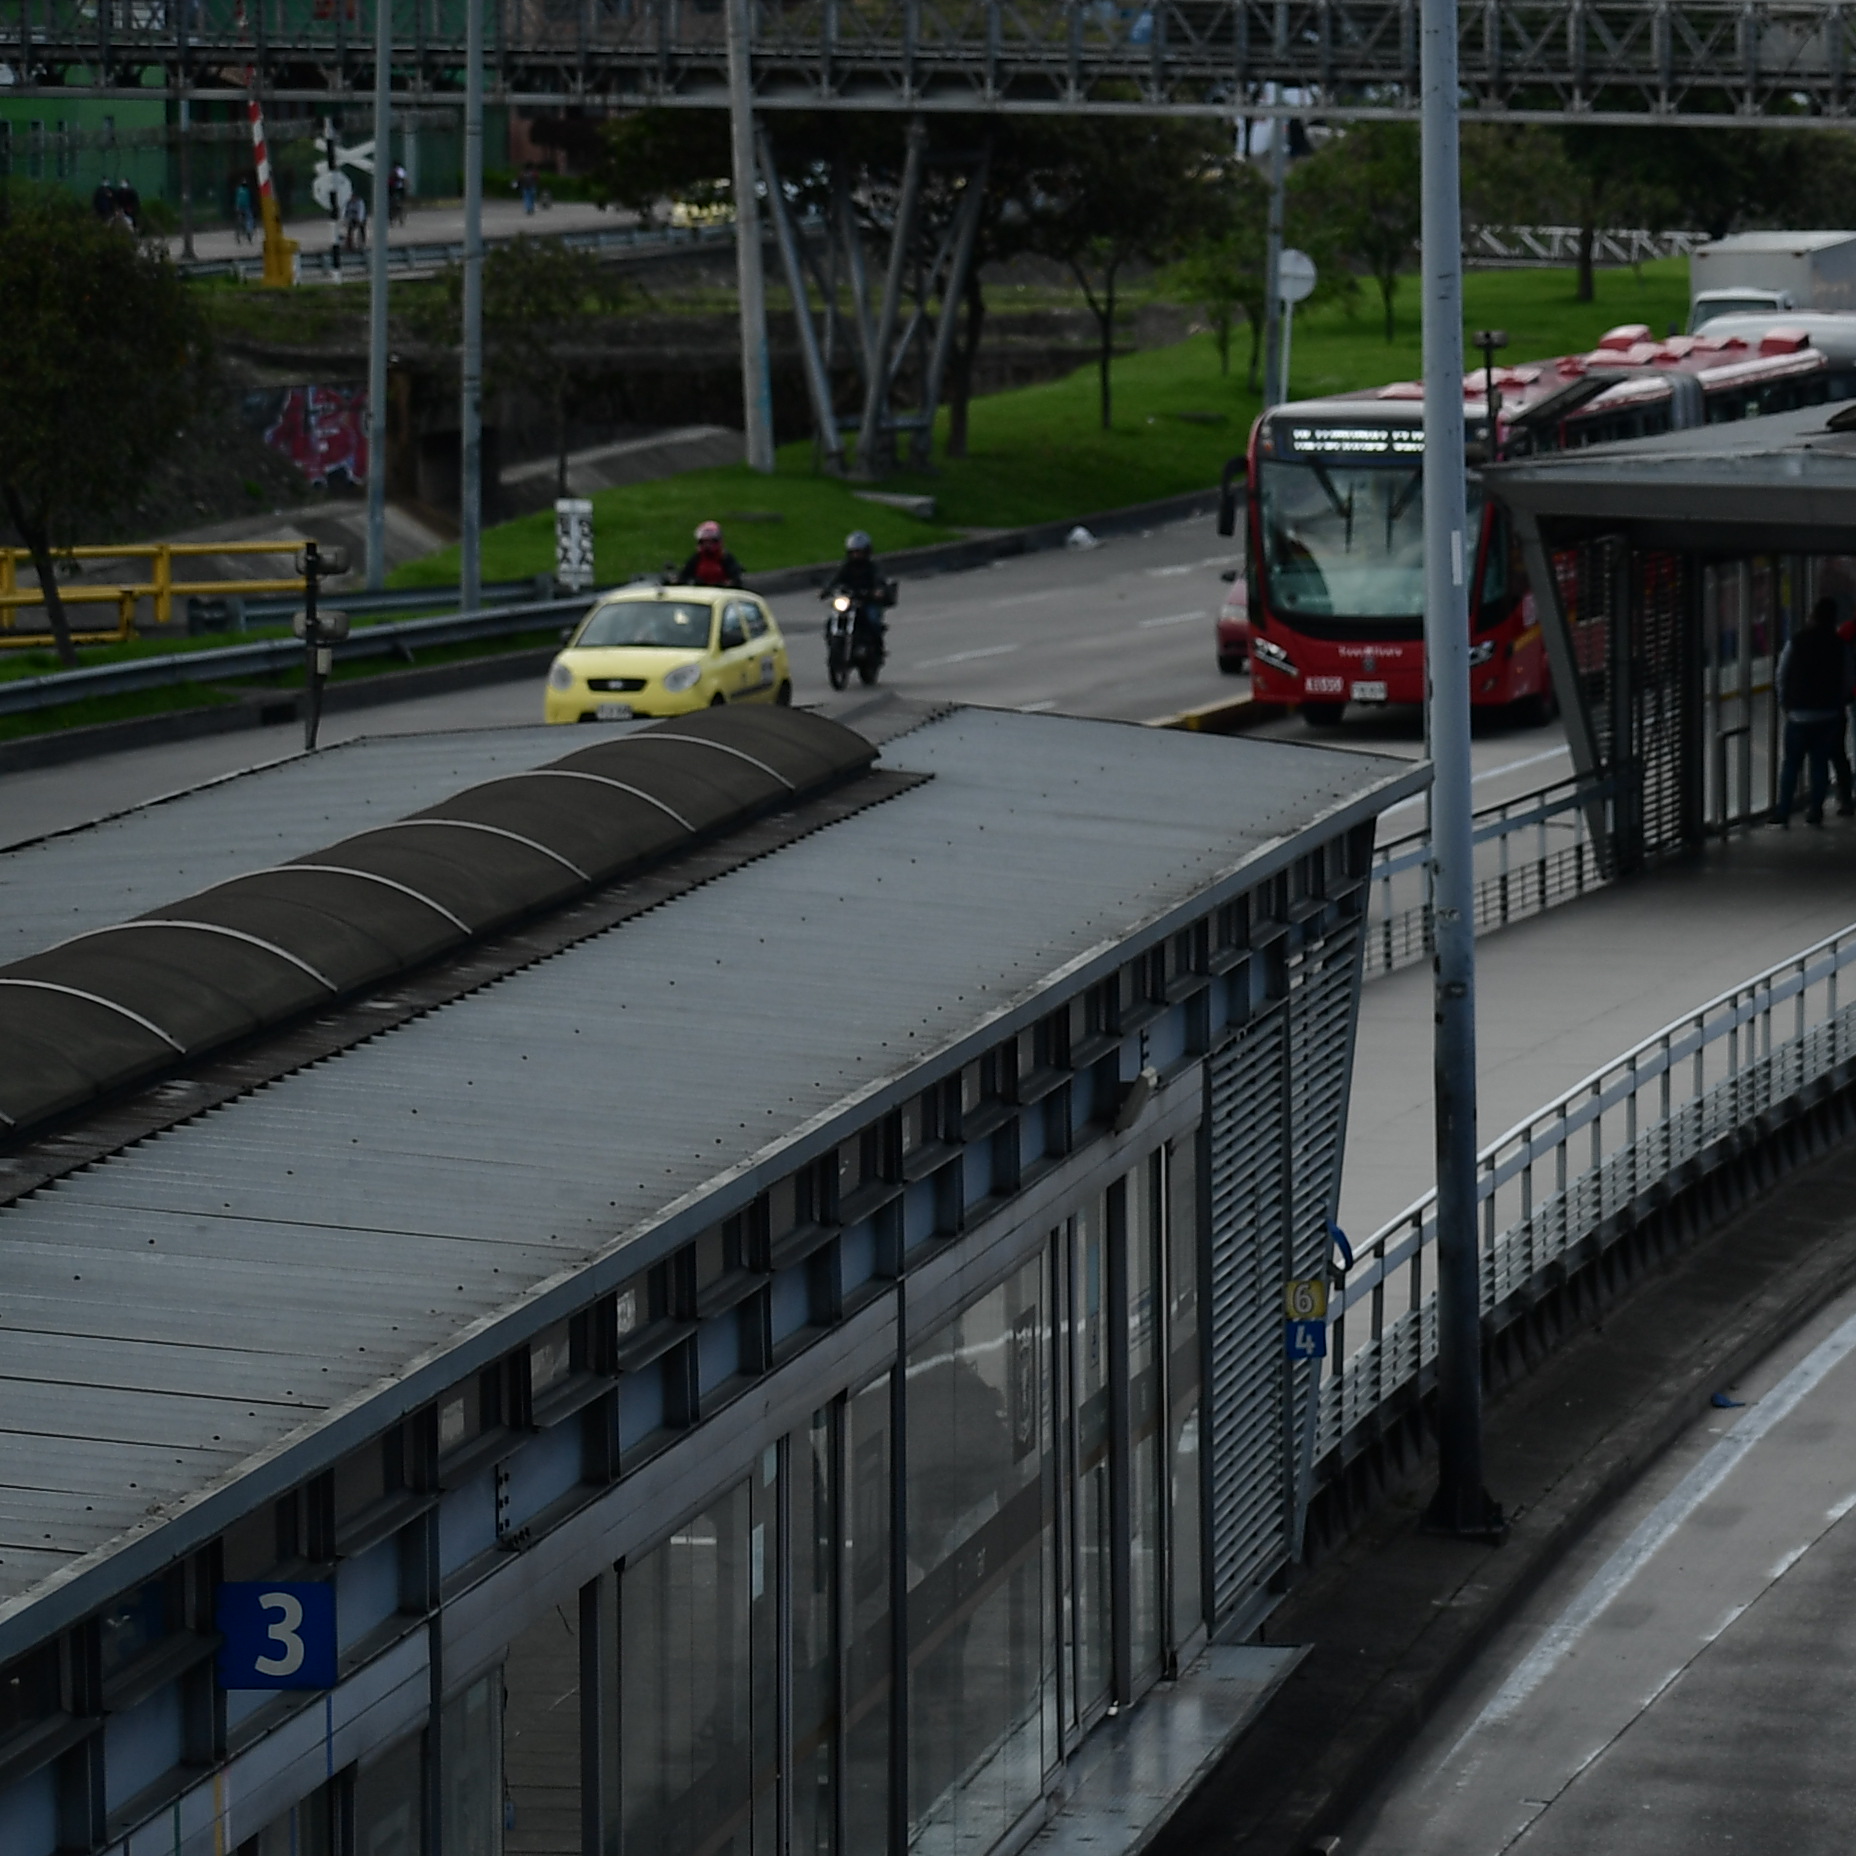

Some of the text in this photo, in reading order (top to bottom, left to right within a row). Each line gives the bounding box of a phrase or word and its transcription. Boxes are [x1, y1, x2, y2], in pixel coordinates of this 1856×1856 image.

[1293, 1281, 1313, 1314] 6
[1294, 1324, 1316, 1355] 4
[254, 1591, 305, 1676] 3
